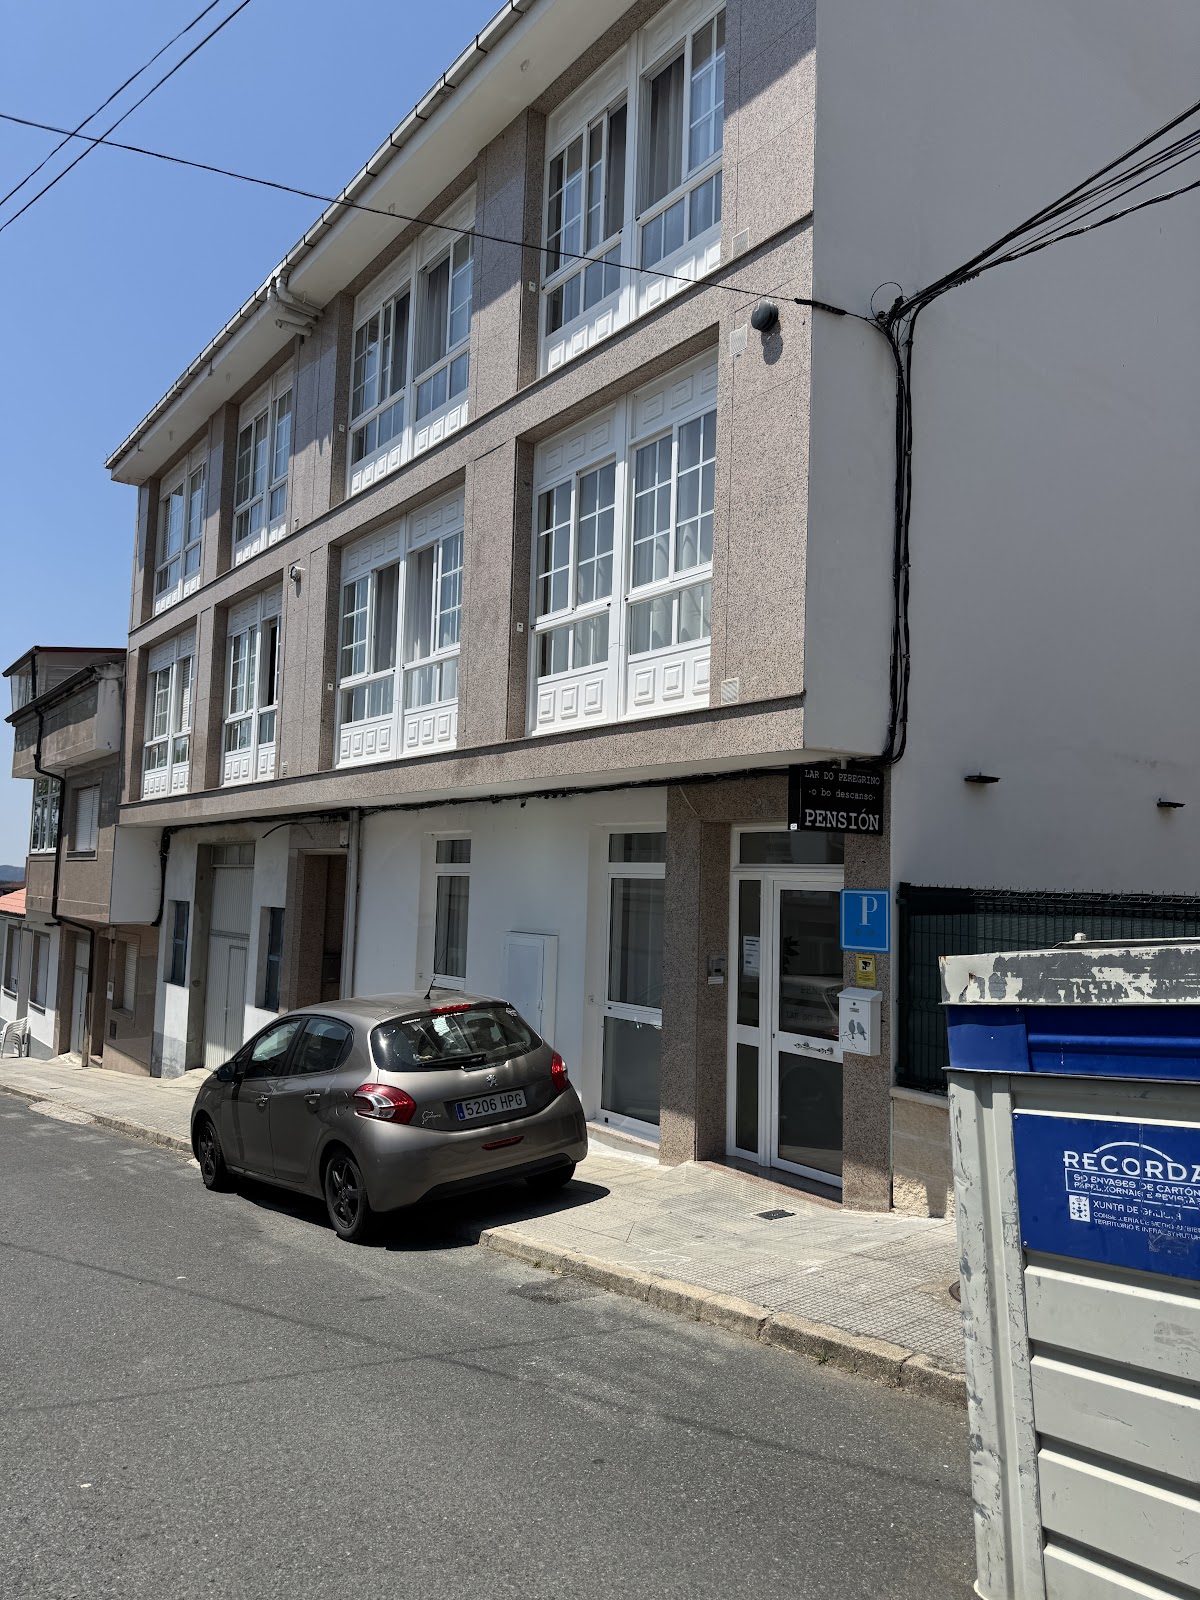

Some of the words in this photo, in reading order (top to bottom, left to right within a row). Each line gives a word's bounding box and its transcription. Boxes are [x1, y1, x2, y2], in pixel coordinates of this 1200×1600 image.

[804, 769, 820, 779] LAR
[824, 771, 834, 780] DO
[838, 773, 880, 785] PEREGRINO
[821, 787, 832, 797] bo
[804, 808, 880, 831] PENSIÓN
[859, 895, 878, 926] P
[465, 1100, 498, 1116] 5206
[500, 1093, 523, 1110] HPG
[1090, 1175, 1136, 1189] ENVASES
[1139, 1182, 1154, 1191] DE
[1156, 1184, 1200, 1197] CARTÓN
[1093, 1200, 1125, 1212] XUNTA
[1126, 1205, 1139, 1214] DE
[1140, 1207, 1182, 1221] GALICA
[1094, 1218, 1134, 1230] TERRITORIO
